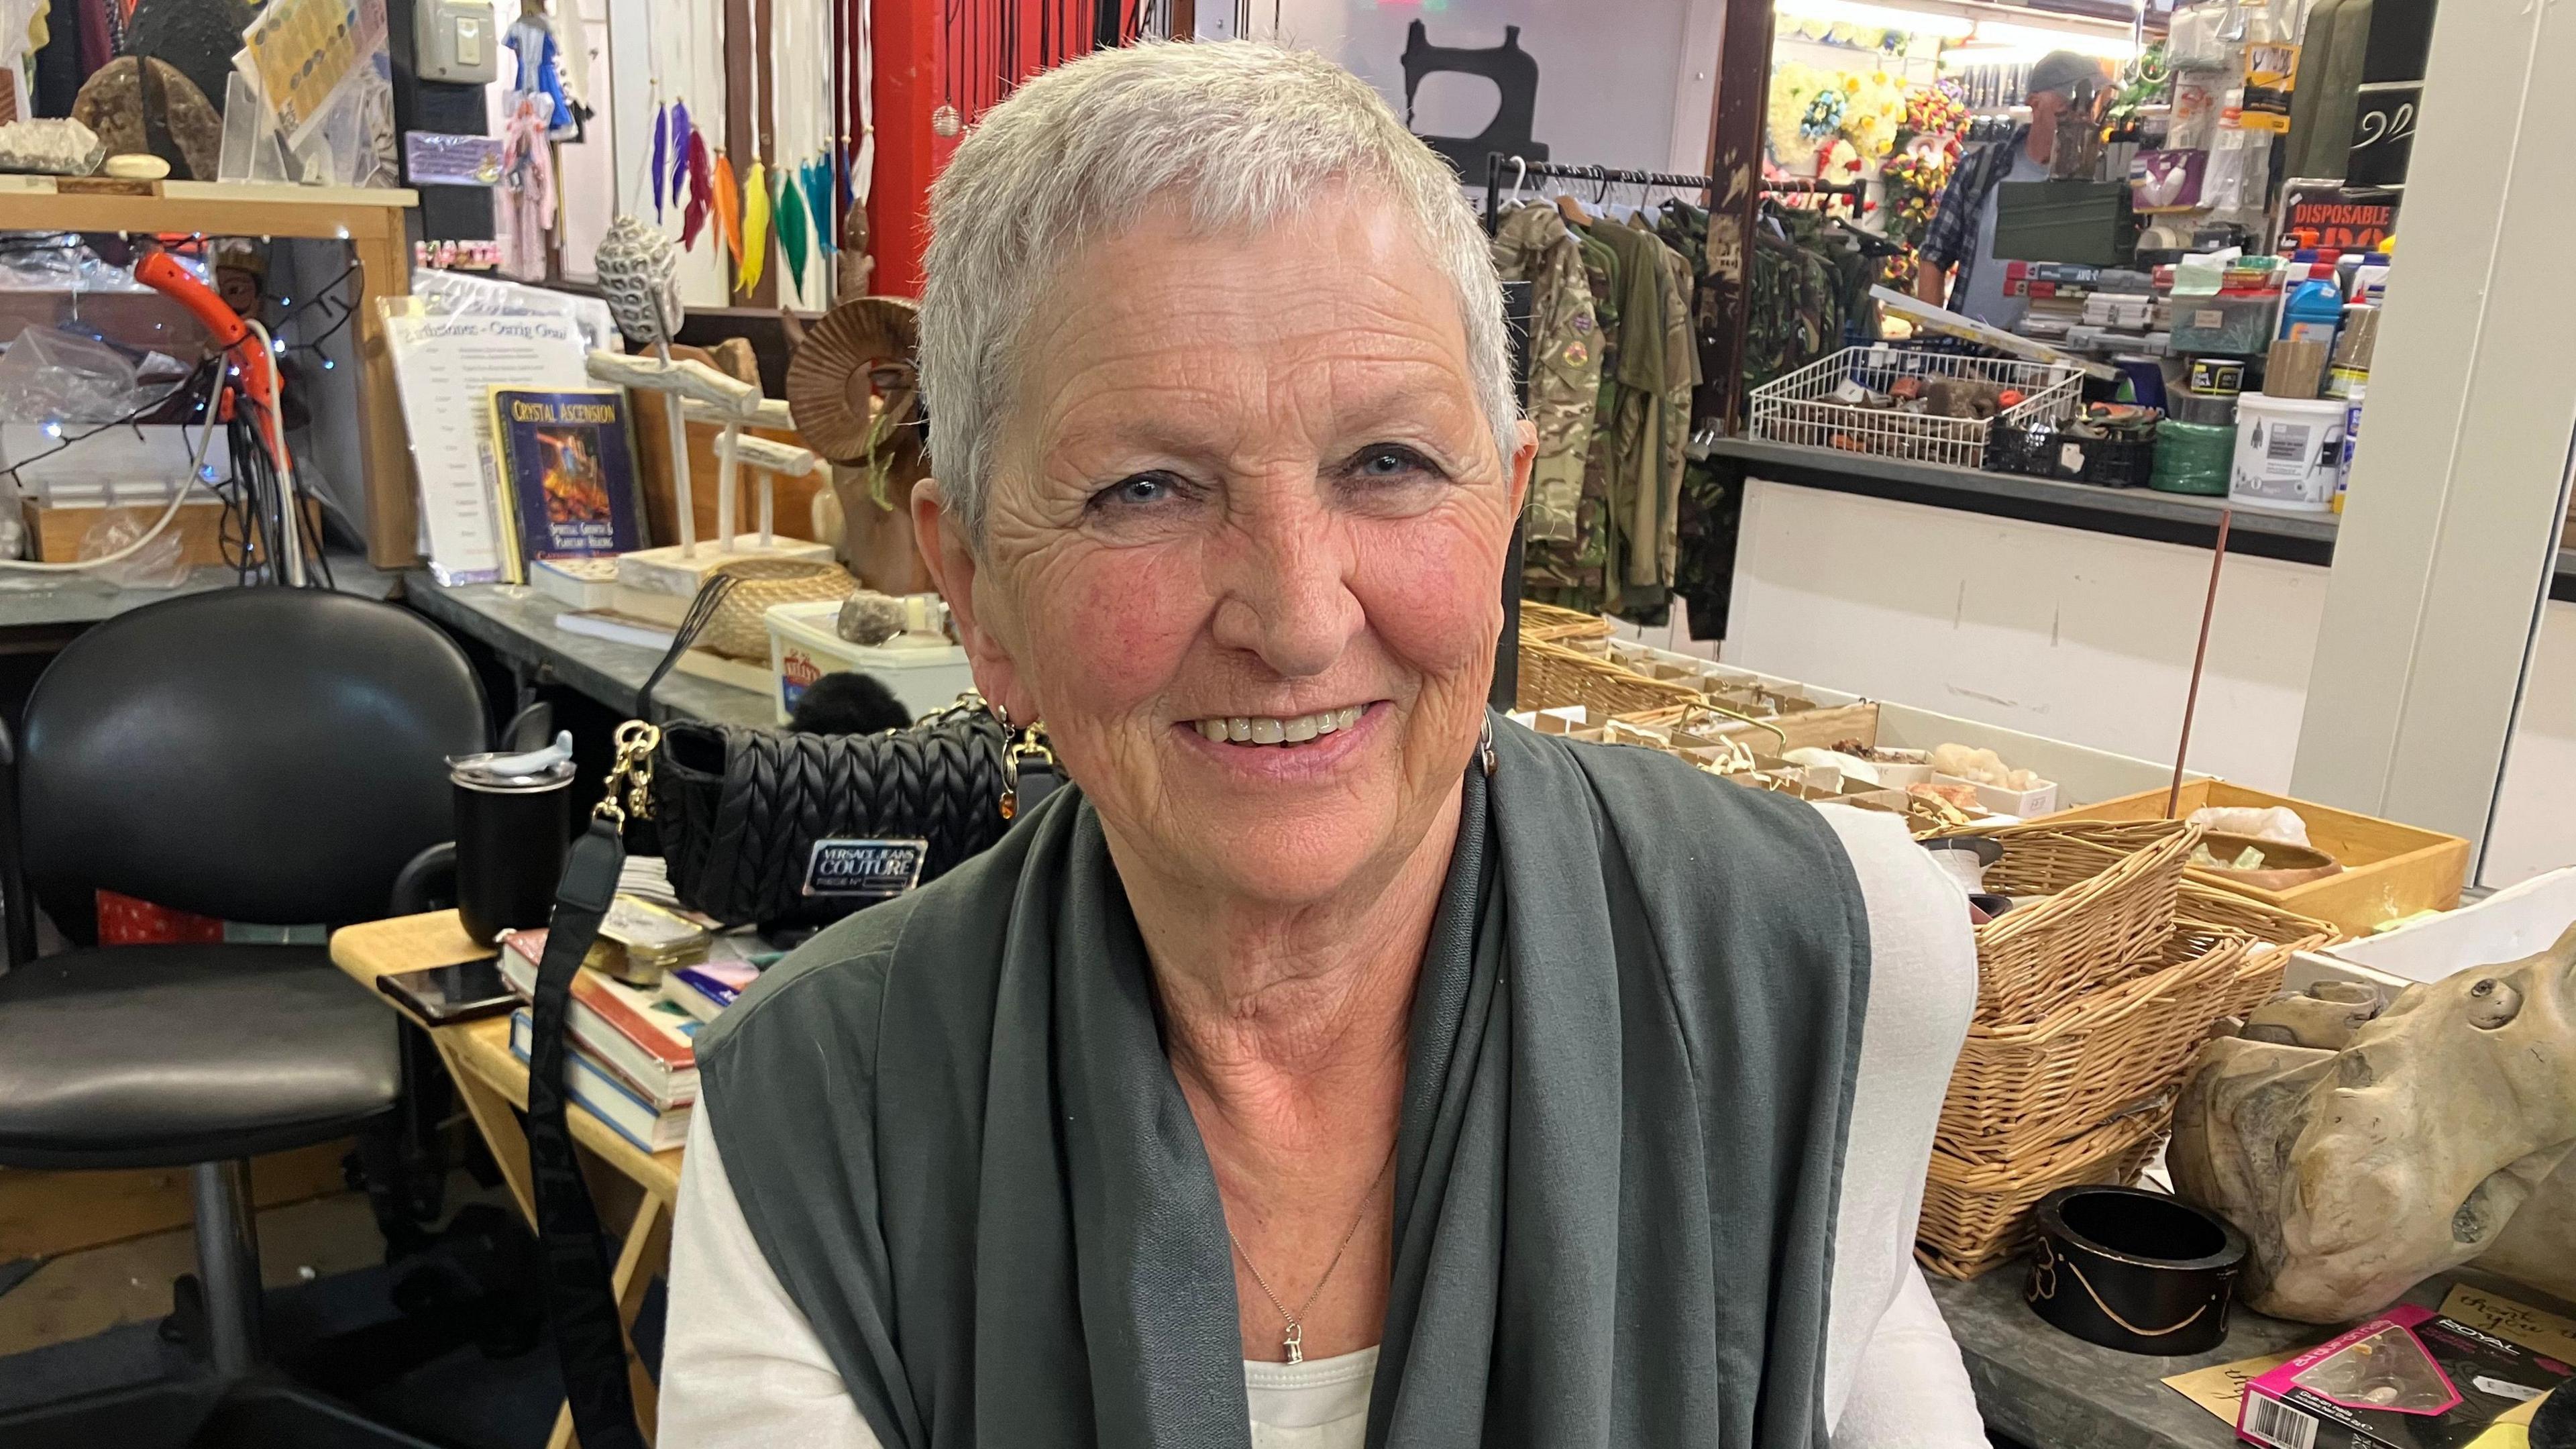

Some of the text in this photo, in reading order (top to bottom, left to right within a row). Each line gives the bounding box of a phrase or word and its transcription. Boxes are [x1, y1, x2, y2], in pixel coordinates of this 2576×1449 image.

[2294, 203, 2390, 225] DISPOSABLE
[512, 399, 616, 424] CRYSTAL ASCENSION
[824, 848, 914, 861] VERSACE JEANS
[820, 859, 911, 876] COUTURE
[2438, 1318, 2521, 1356] ROYAL
[2332, 1405, 2353, 1417] nails
